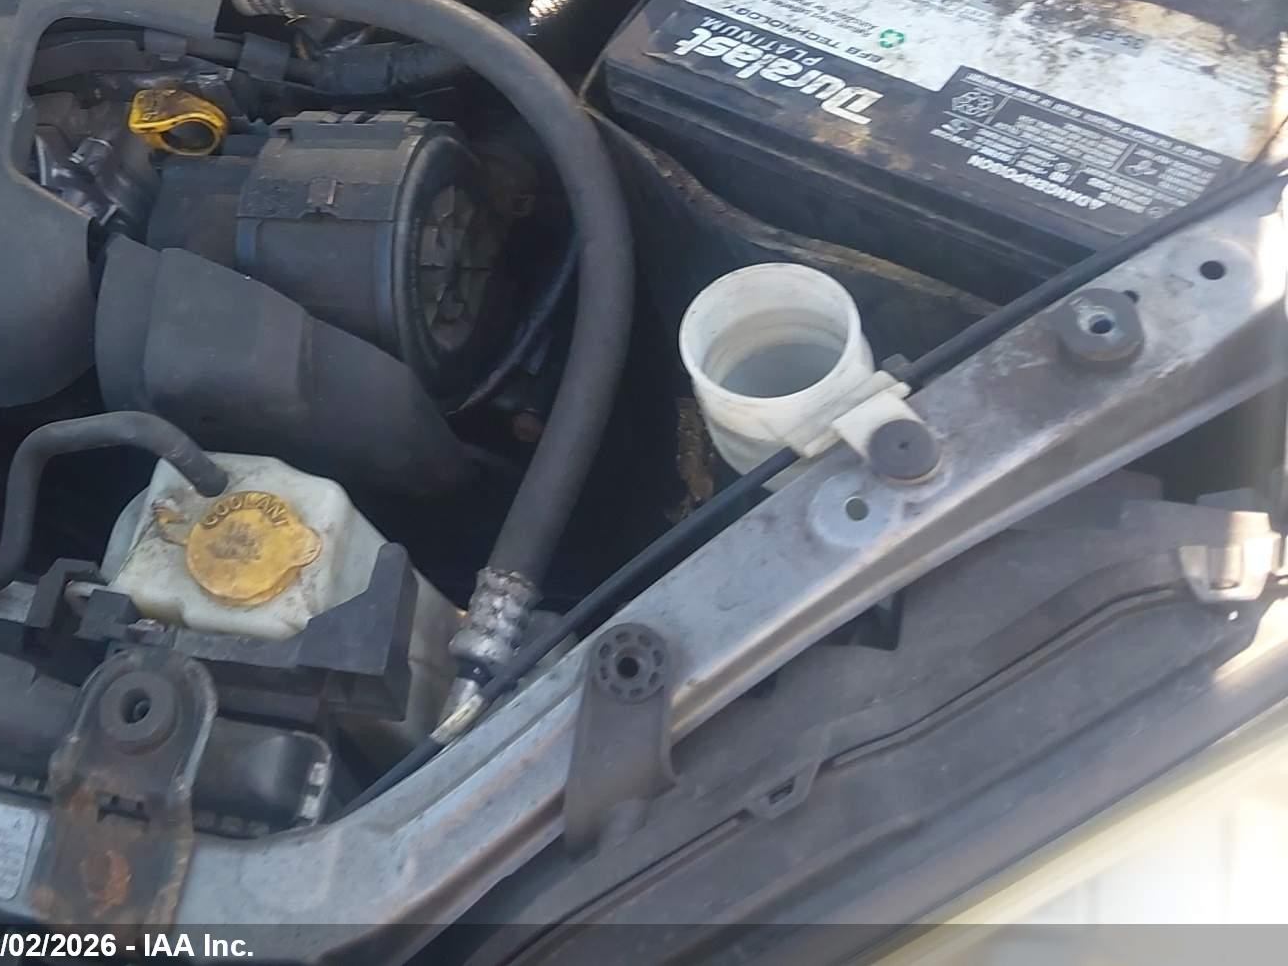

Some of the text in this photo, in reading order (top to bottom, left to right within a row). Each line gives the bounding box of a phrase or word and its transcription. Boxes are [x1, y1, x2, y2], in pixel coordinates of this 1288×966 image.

[722, 3, 883, 63] EFB TECHNOLOGY
[673, 26, 885, 125] Duralast
[202, 492, 289, 528] COOLANT
